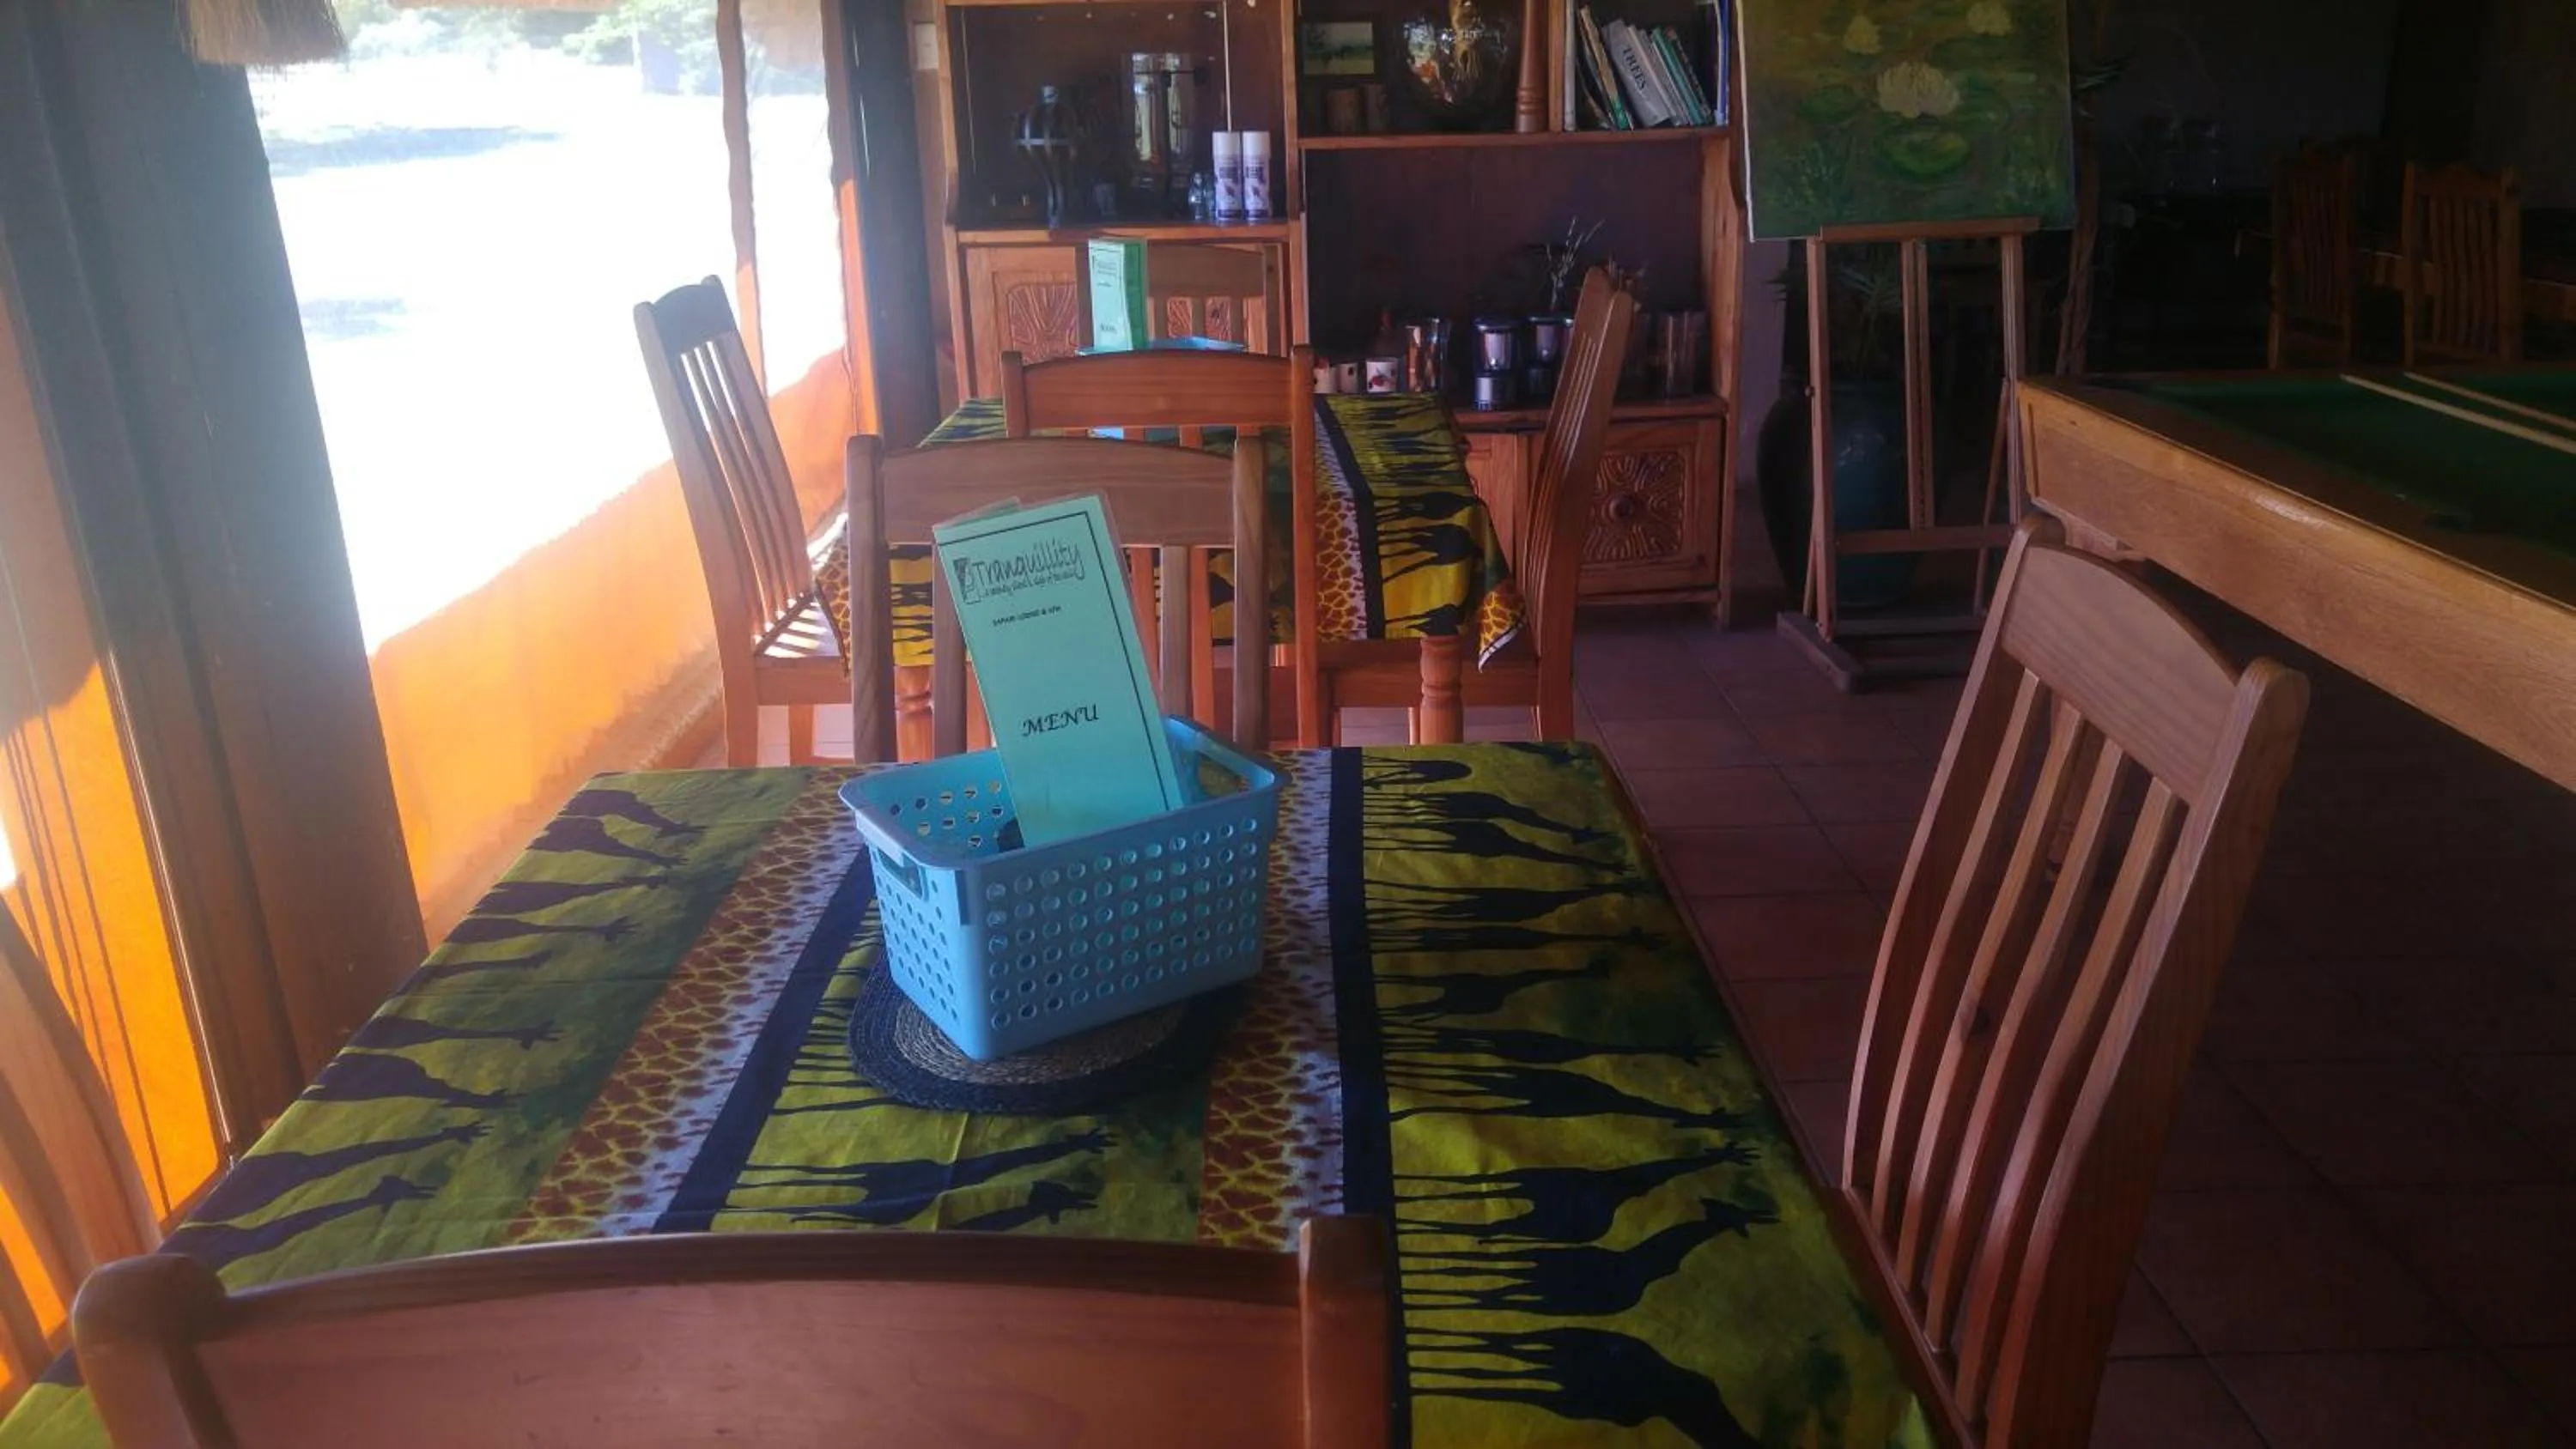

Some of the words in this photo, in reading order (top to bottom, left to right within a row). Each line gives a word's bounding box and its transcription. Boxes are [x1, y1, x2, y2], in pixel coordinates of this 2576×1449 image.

[1623, 46, 1646, 91] TREES
[972, 538, 1085, 585] Tranquillity
[1022, 703, 1100, 737] MENU
